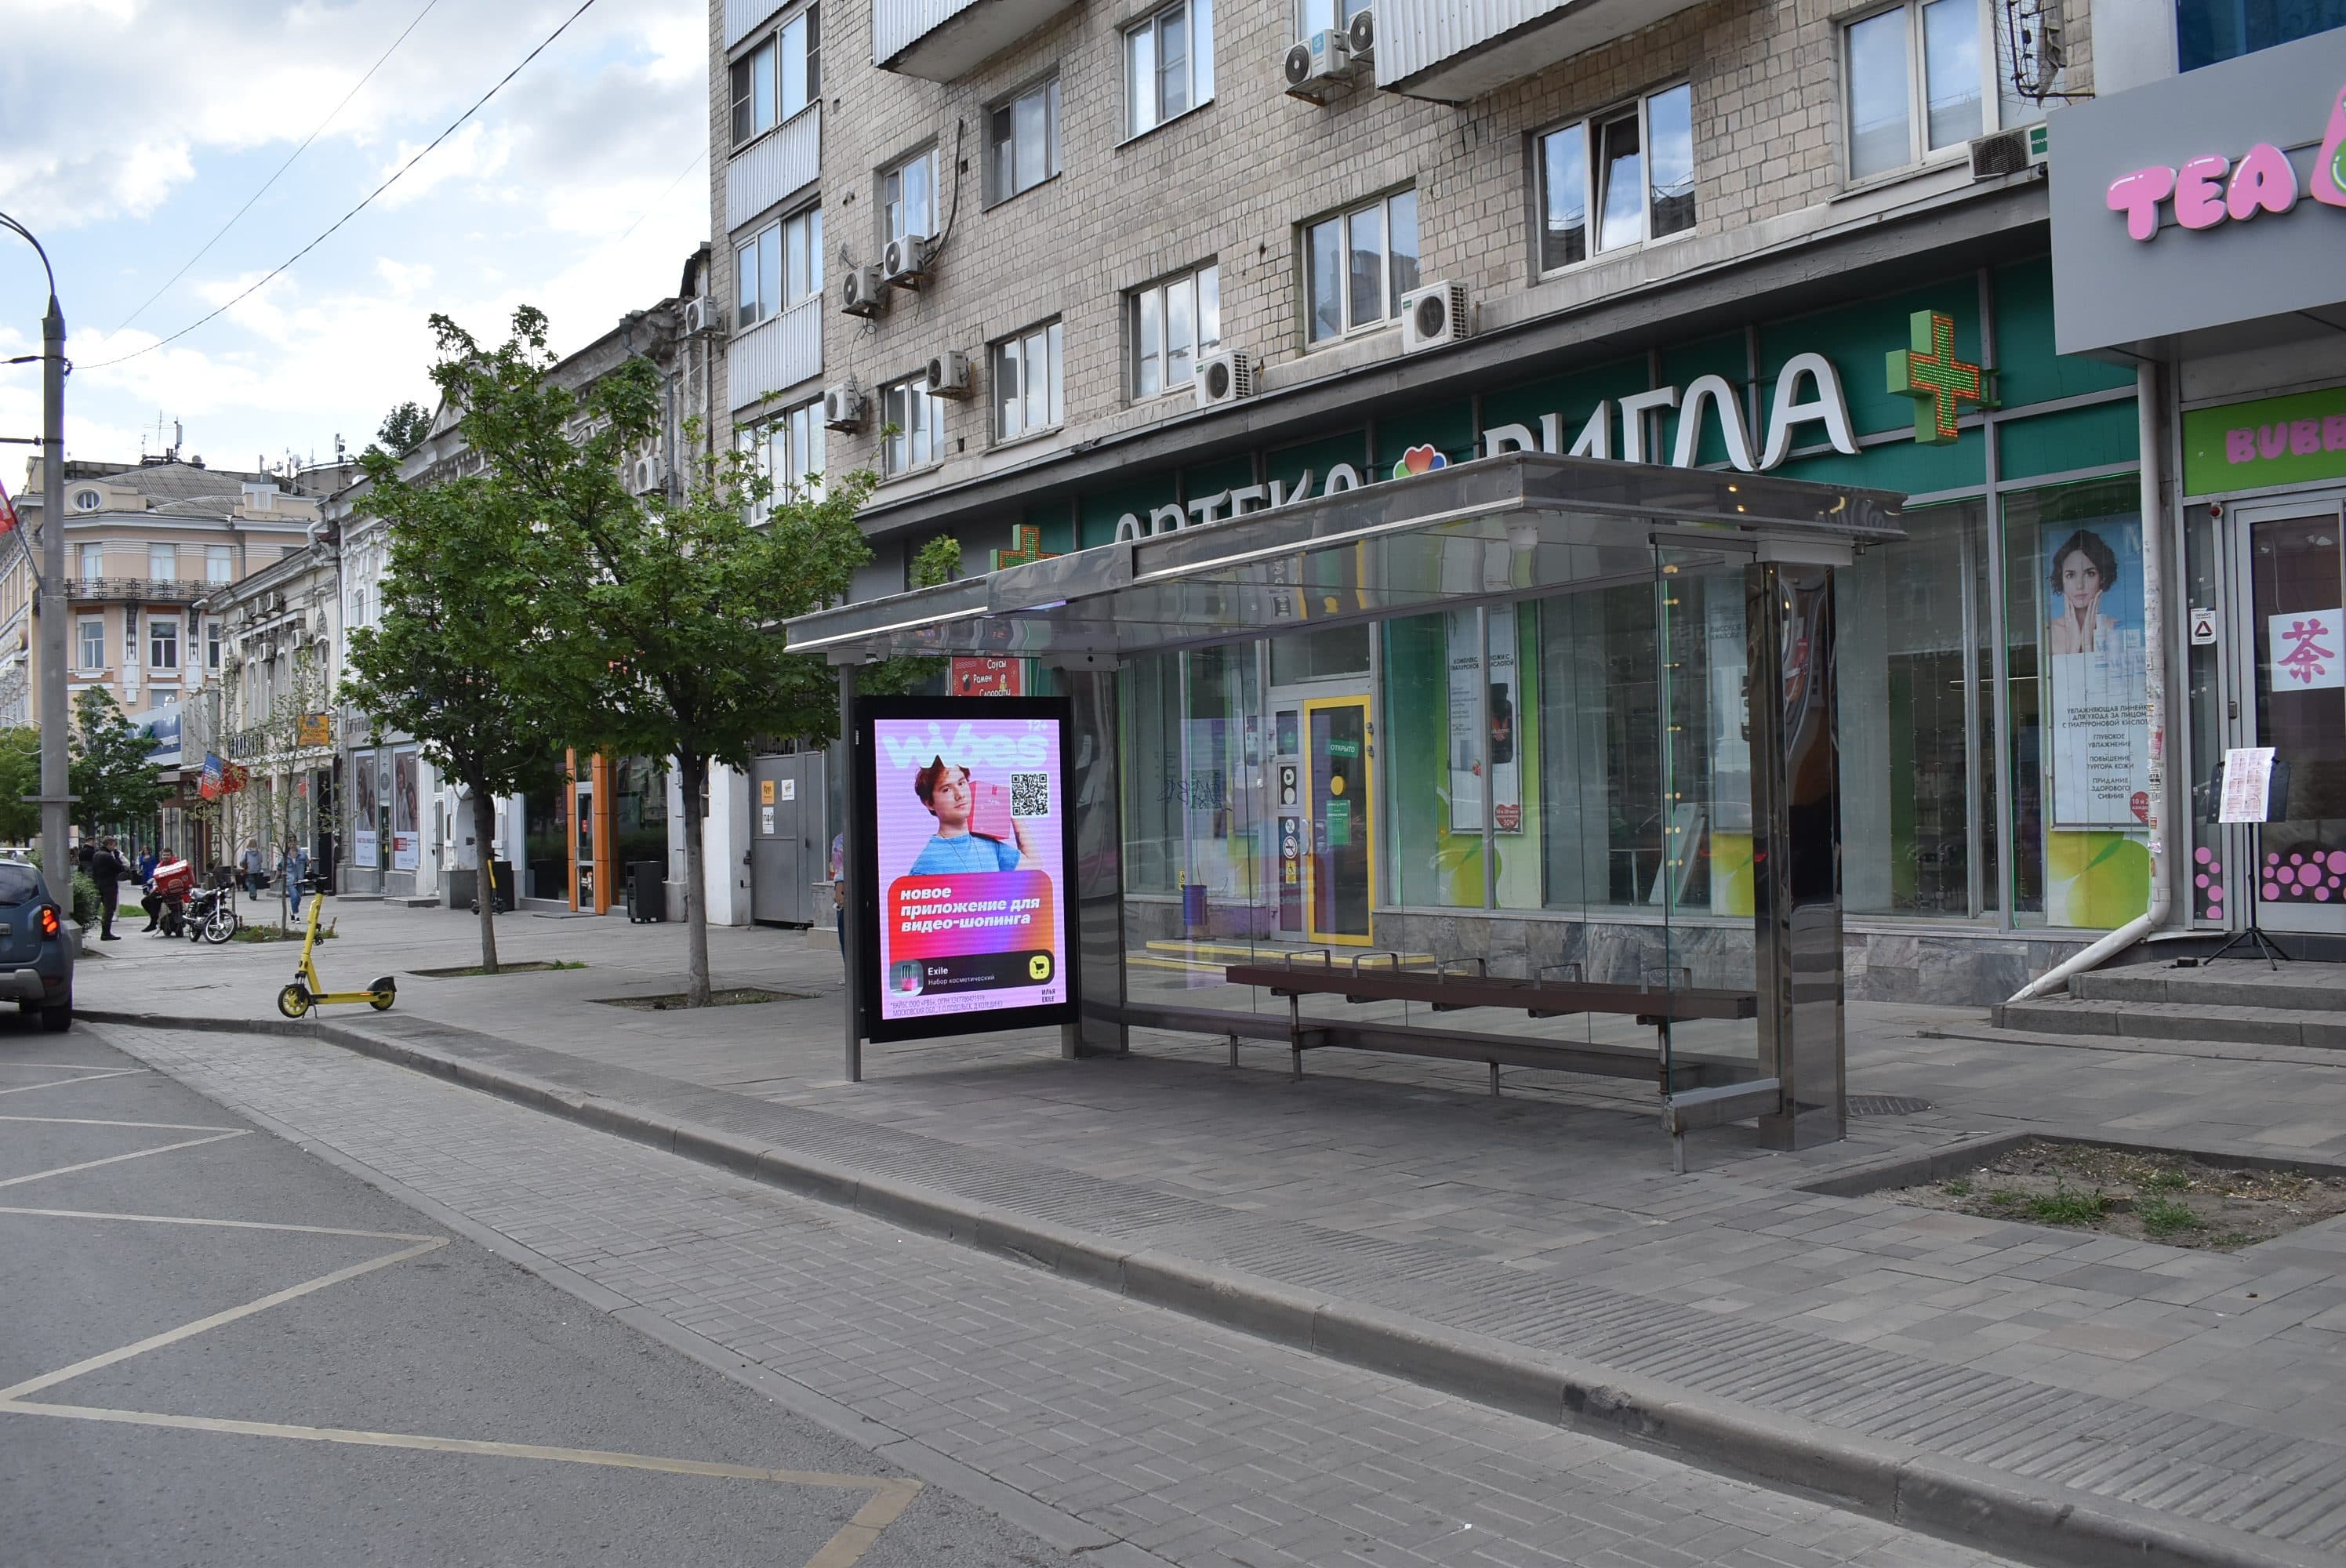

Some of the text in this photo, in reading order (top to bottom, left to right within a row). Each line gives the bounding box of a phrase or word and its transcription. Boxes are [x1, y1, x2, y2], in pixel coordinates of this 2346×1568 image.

[2107, 143, 2297, 241] TEA
[2226, 414, 2346, 464] BUBB
[2278, 619, 2335, 684] 茶
[986, 659, 1007, 670] Соусы
[973, 673, 993, 684] Рамен
[1027, 720, 1048, 732] 12+
[2068, 719, 2119, 728] ГИАЛУРОНОВОЙ
[1330, 744, 1355, 753] ОТКРЫТО
[211, 806, 220, 860] ВЕЛИР
[900, 887, 951, 901] новое
[900, 897, 1040, 920] приложение для
[901, 913, 1030, 933] видео-шопинга
[928, 966, 949, 976] Exile
[949, 974, 995, 984] косметический
